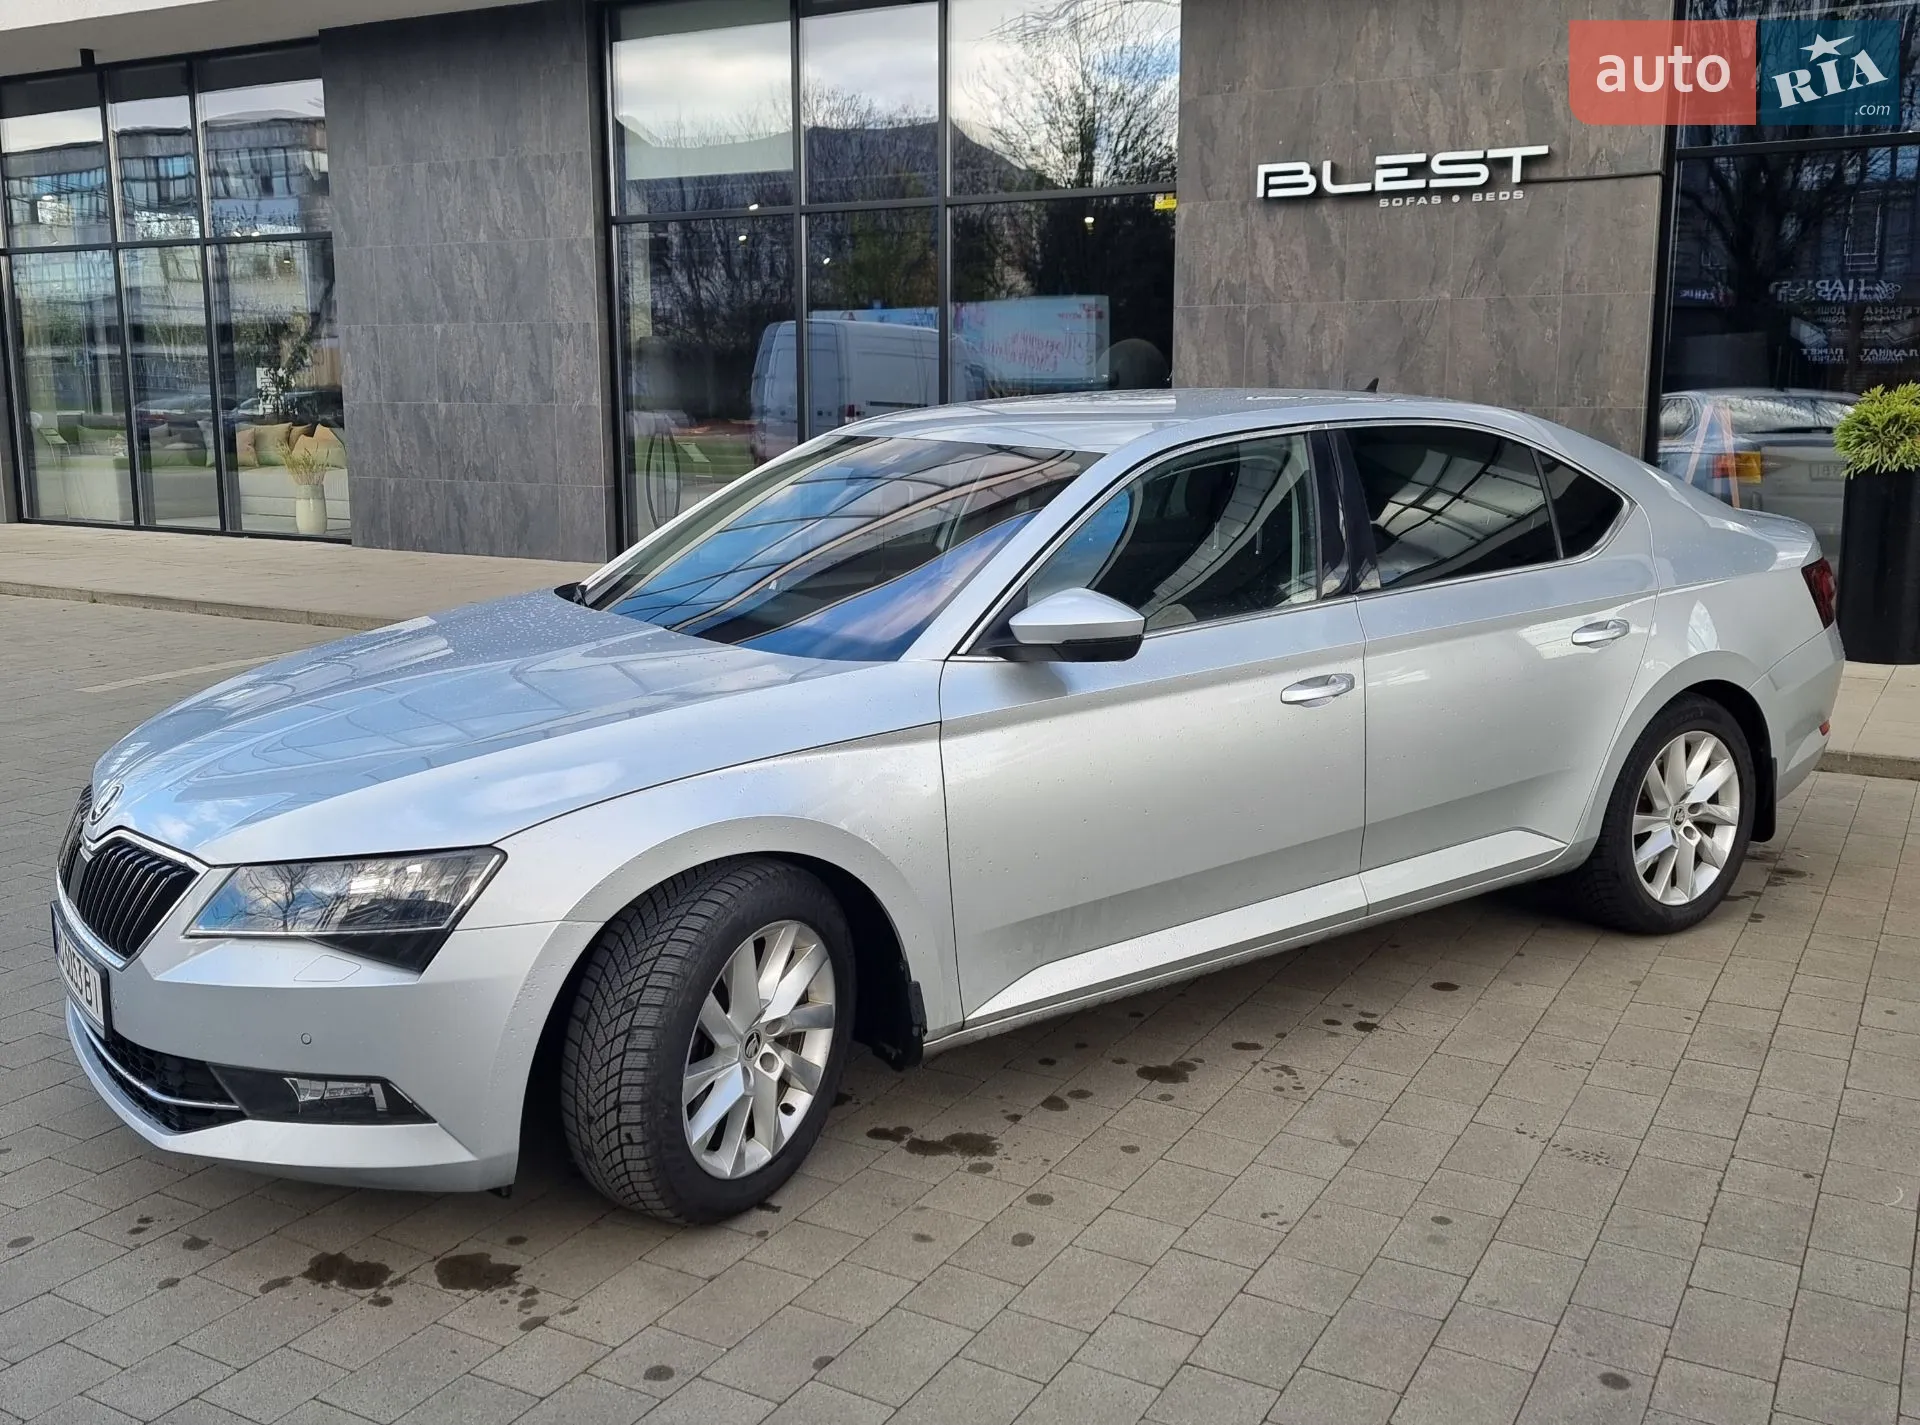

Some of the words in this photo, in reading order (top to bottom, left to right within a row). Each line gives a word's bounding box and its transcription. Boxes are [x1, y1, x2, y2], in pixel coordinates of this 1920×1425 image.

[1256, 145, 1549, 198] BLEST
[1379, 195, 1442, 208] SOFAS
[1472, 190, 1525, 203] BEDS
